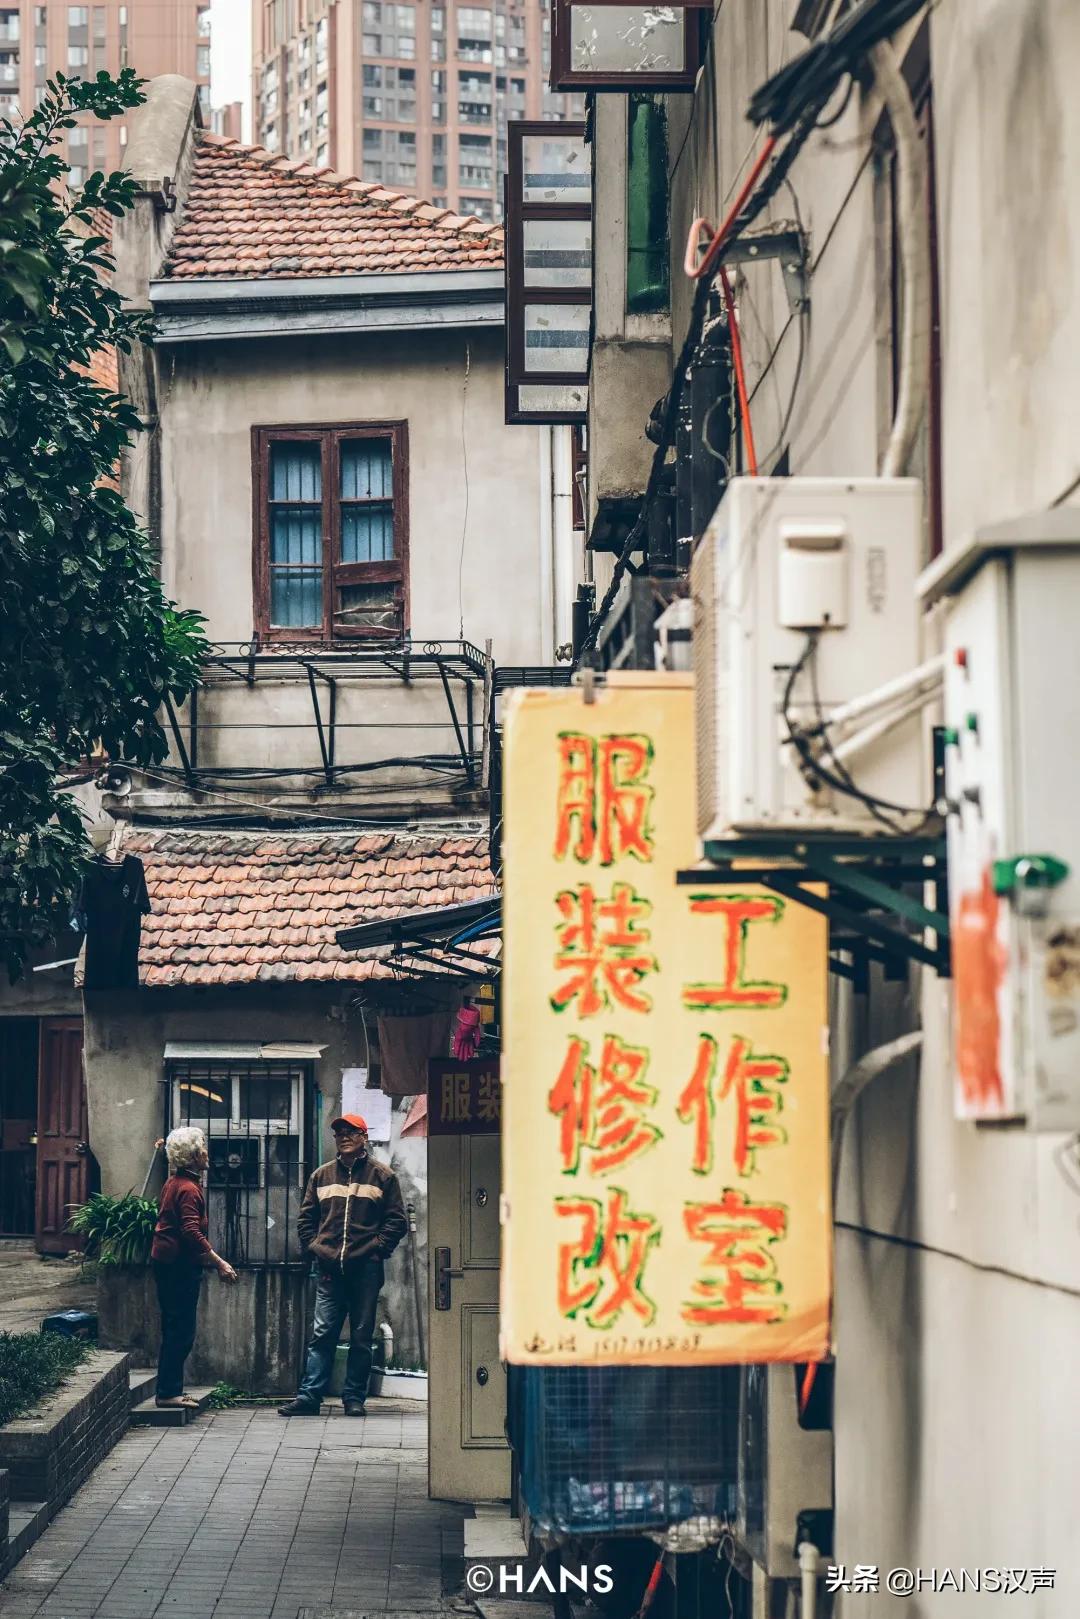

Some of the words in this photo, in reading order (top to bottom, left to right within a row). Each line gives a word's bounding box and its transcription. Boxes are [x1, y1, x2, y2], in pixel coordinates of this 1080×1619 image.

[440, 1071, 502, 1121] 服装
[549, 731, 661, 1329] 服装修改
[677, 894, 789, 1325] 工作室
